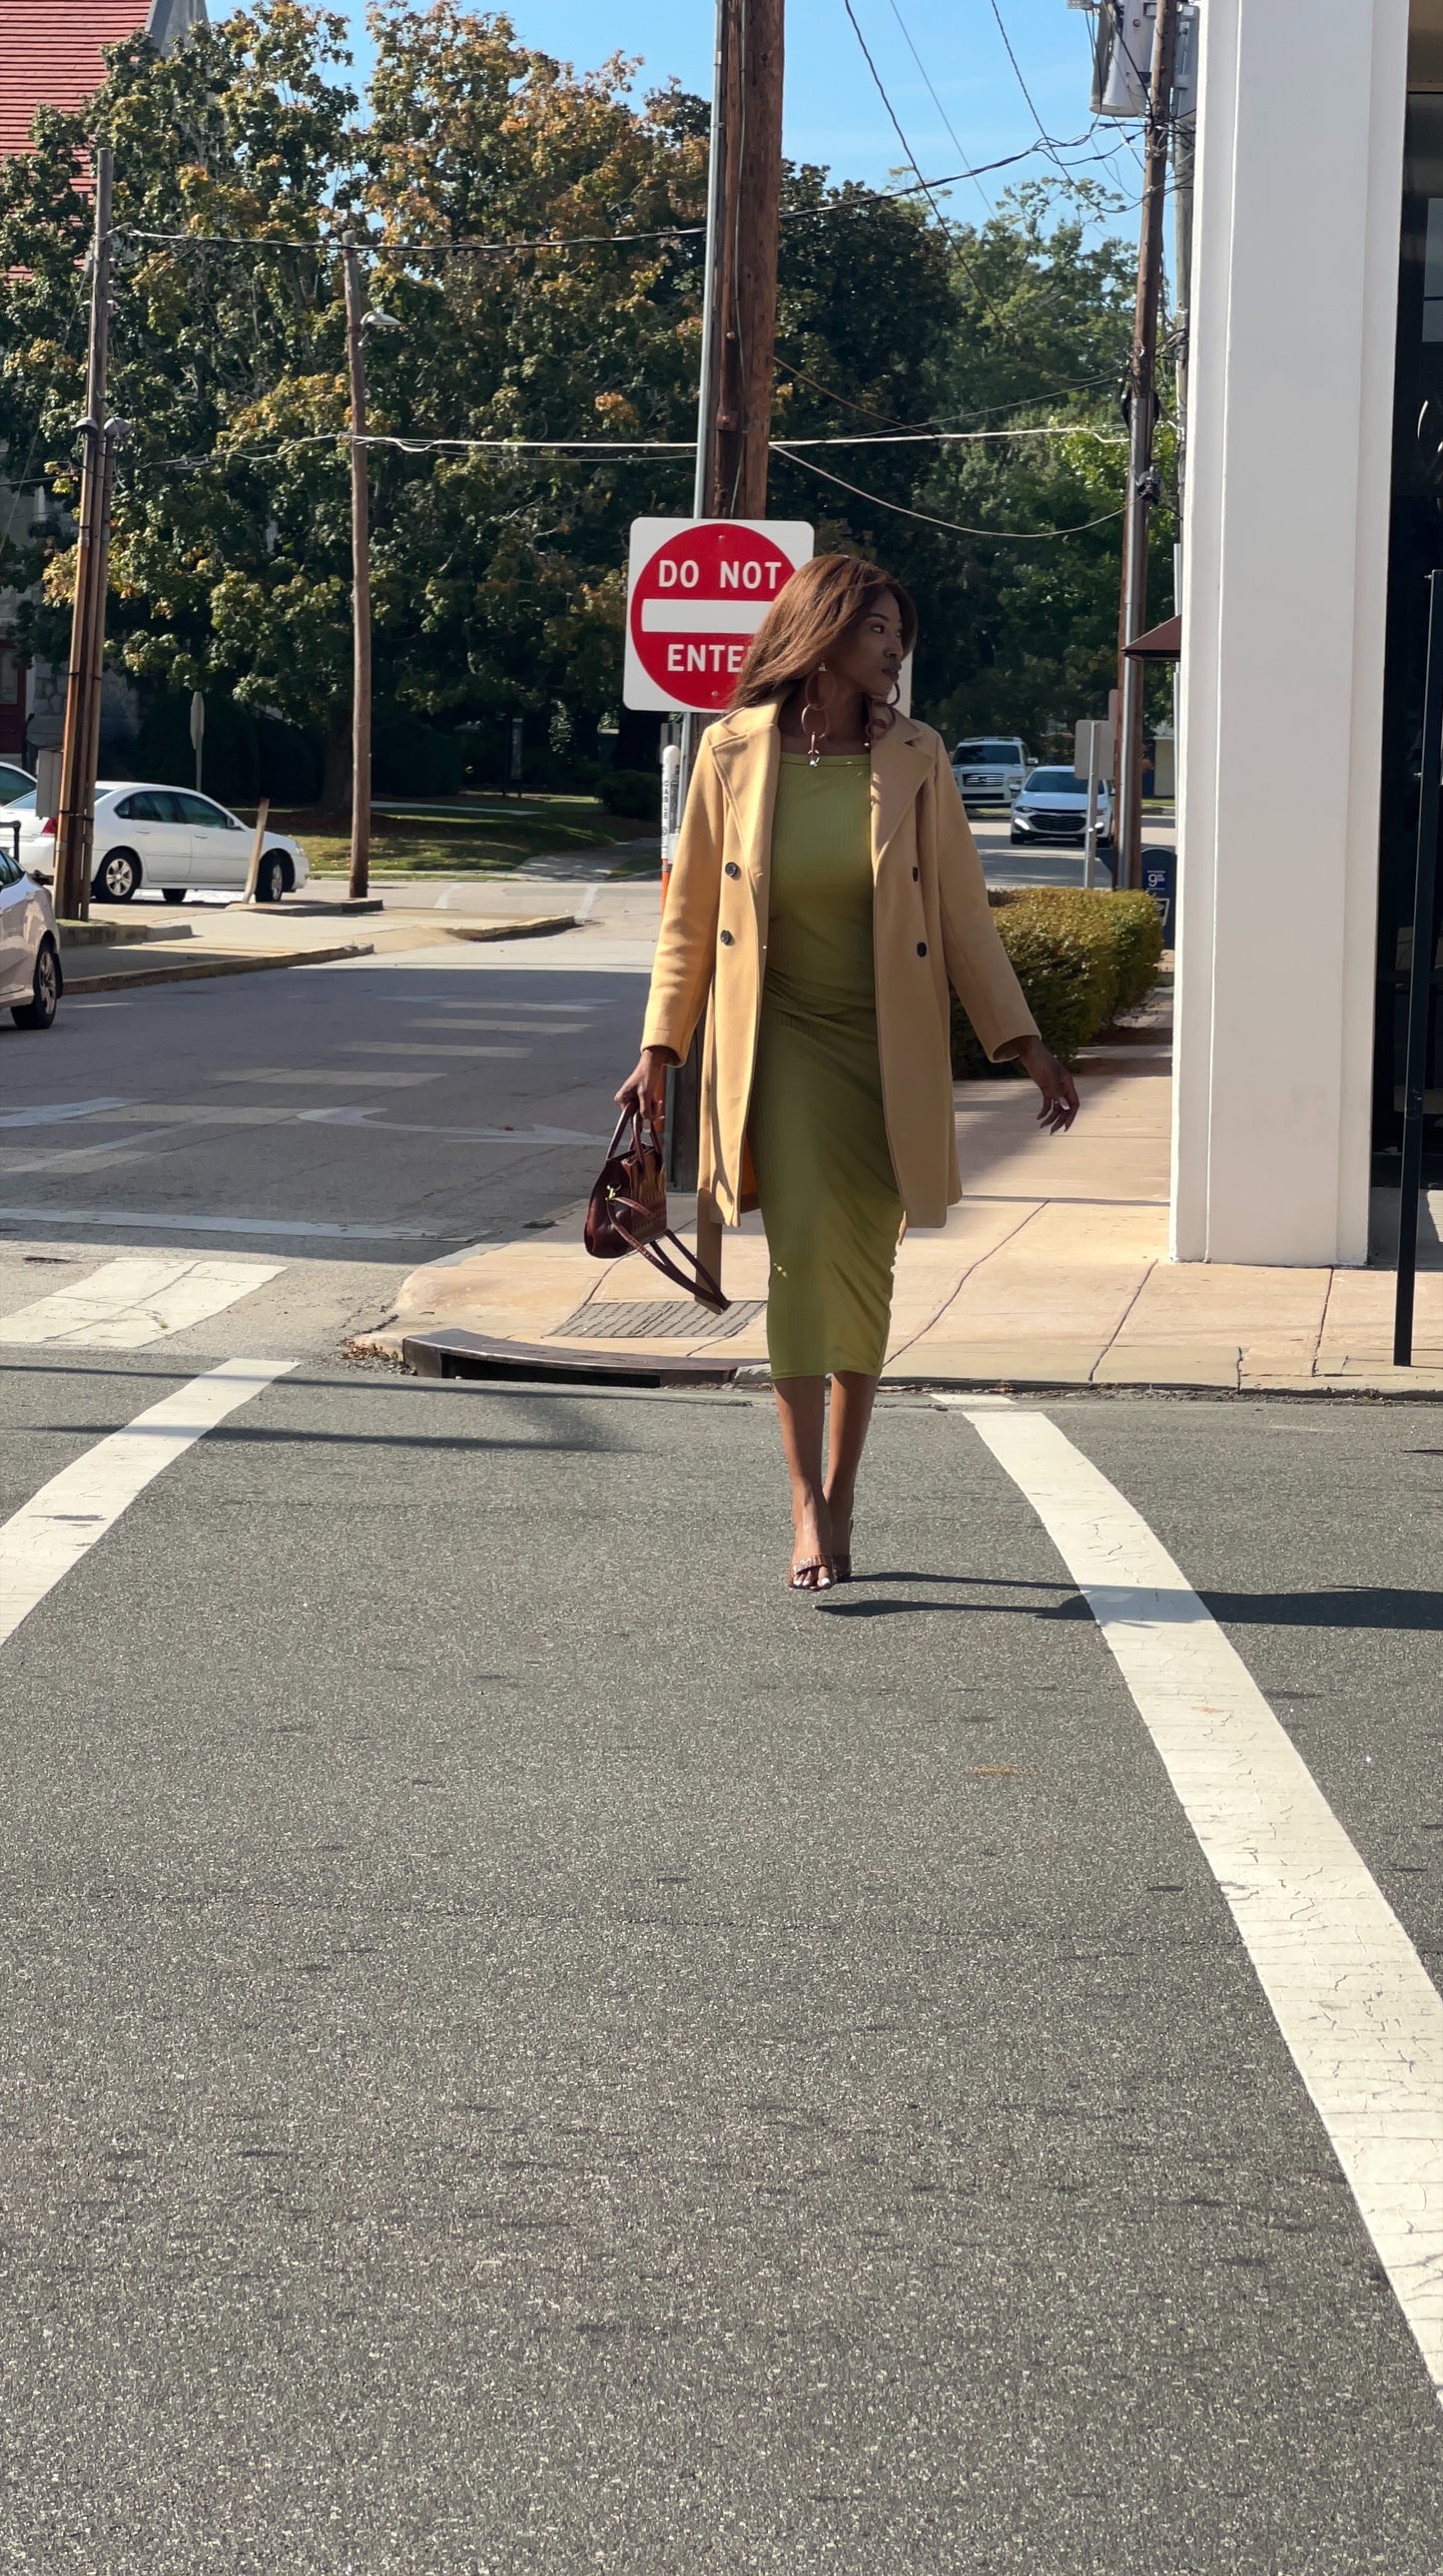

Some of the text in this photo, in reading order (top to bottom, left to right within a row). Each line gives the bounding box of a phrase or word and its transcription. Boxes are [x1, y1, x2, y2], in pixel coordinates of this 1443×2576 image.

[659, 559, 782, 589] DO NOT
[667, 644, 751, 673] ENTE
